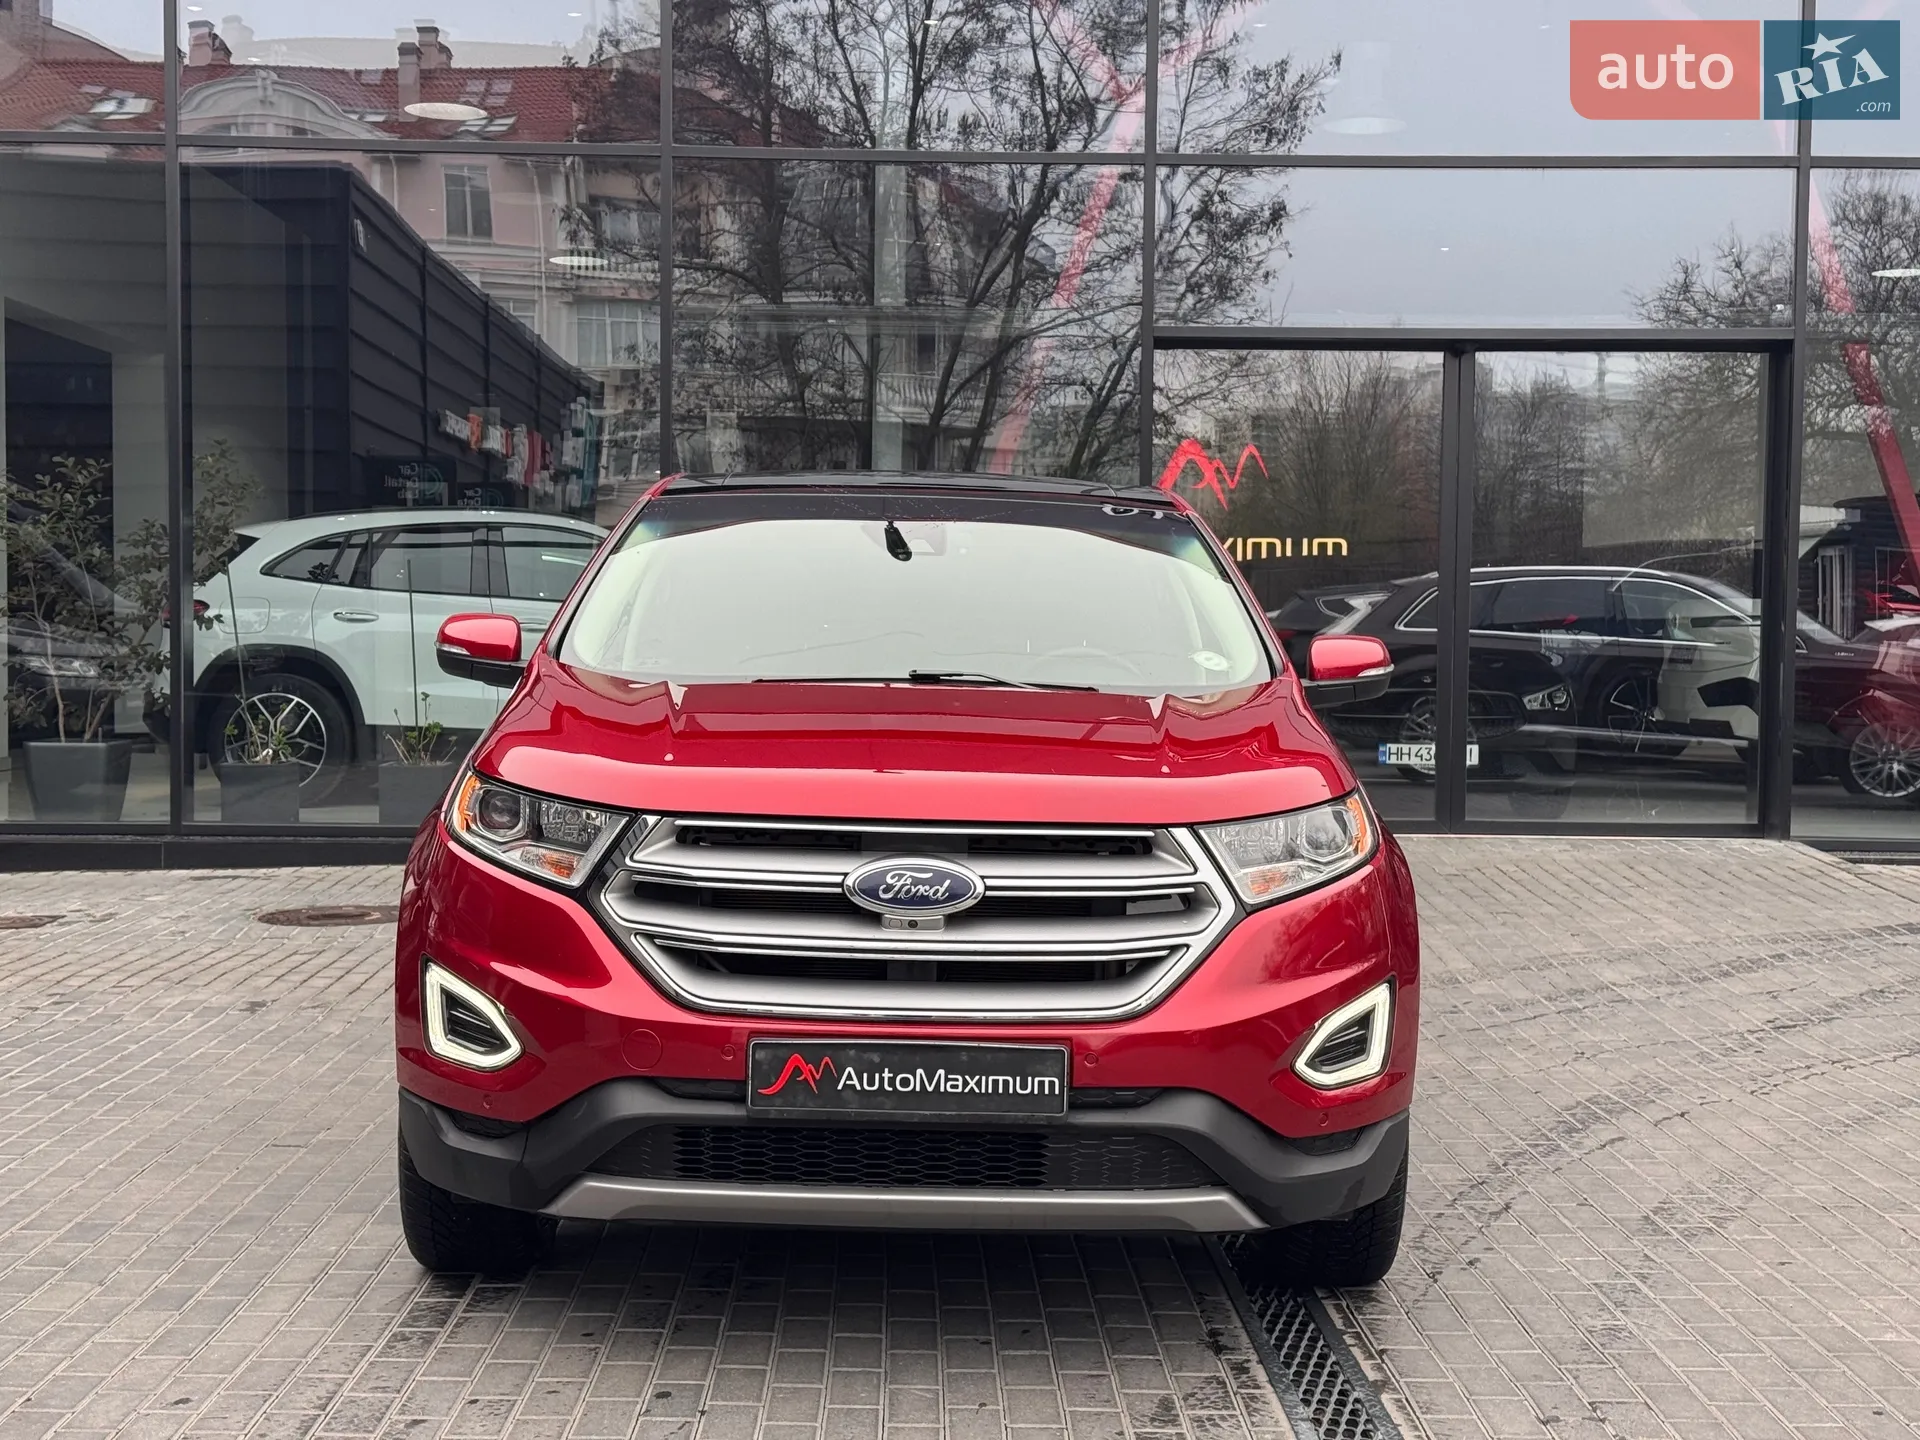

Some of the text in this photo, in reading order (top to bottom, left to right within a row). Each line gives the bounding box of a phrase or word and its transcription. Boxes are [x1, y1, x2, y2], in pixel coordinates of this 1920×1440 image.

[1388, 747, 1411, 762] HH
[1414, 747, 1436, 762] 43
[878, 870, 951, 900] Ford
[837, 1067, 1060, 1095] AutoMaximum
